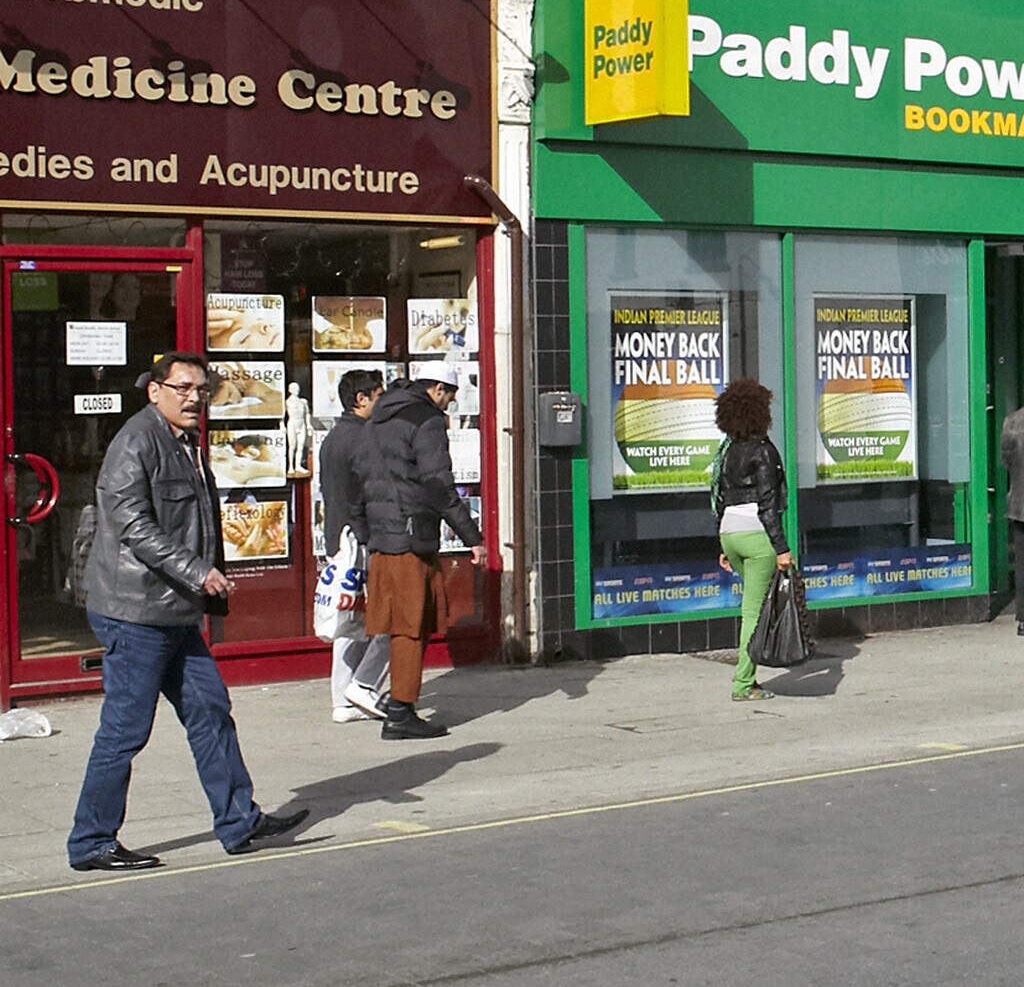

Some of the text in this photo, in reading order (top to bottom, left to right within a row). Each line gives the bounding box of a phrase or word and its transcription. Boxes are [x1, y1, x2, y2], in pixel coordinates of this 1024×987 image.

[594, 17, 653, 50] Paddy
[593, 51, 654, 80] Power
[687, 14, 890, 100] Paddy
[0, 49, 457, 120] Medicine Centre
[111, 154, 178, 183] and
[200, 155, 419, 195] Acupuncture
[207, 295, 283, 311] Acupuncture
[411, 309, 475, 327] Diabetes
[614, 309, 719, 325] INDIAN PREMIER LEAGUE
[817, 308, 908, 323] INDIAN PREMIER LEAGUE
[615, 332, 720, 358] MONEY BACK
[818, 330, 909, 354] MONEY BACK
[615, 360, 720, 385] FINAL BALL
[818, 356, 909, 380] FINAL BALL
[82, 397, 113, 411] CLOSED
[626, 445, 710, 457] WATCH EVERY GAME
[828, 436, 900, 447] WATCH EVERY GAME
[848, 446, 884, 457] LIVE HERE
[649, 455, 690, 467] LIVE HERE
[803, 576, 828, 589] CHES
[831, 574, 854, 586] HERE
[866, 572, 883, 584] ALL
[885, 570, 905, 582] LIVE
[907, 567, 949, 581] MATCHES
[594, 585, 720, 605] ALL LIVE MATCHES HERE
